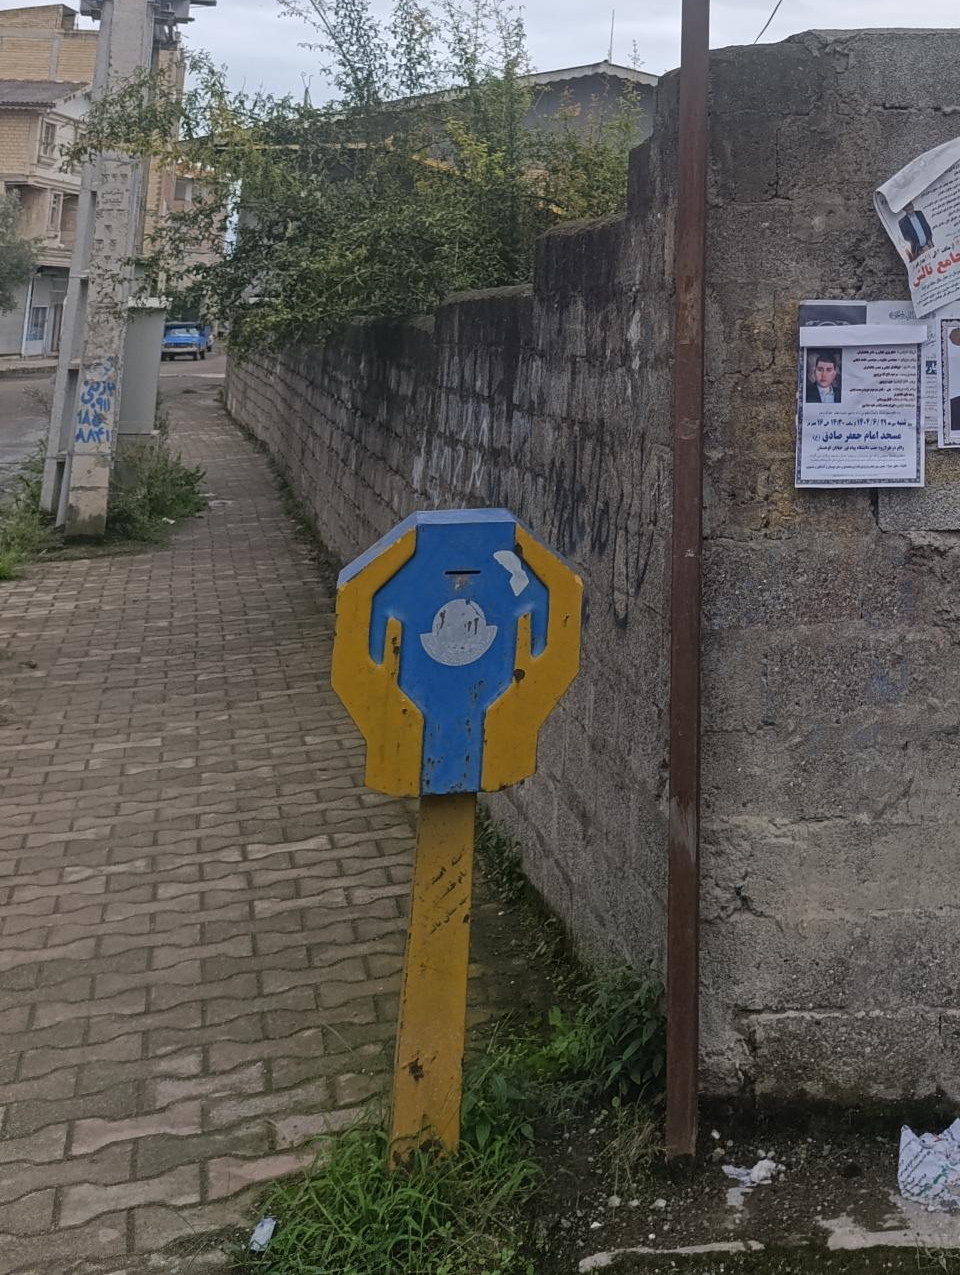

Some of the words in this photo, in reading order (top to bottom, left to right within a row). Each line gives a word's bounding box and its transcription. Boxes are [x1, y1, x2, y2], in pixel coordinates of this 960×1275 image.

[822, 431, 842, 442] صادق
[844, 432, 862, 443] جعفر
[864, 431, 879, 441] امام
[880, 431, 902, 440] مسجد
